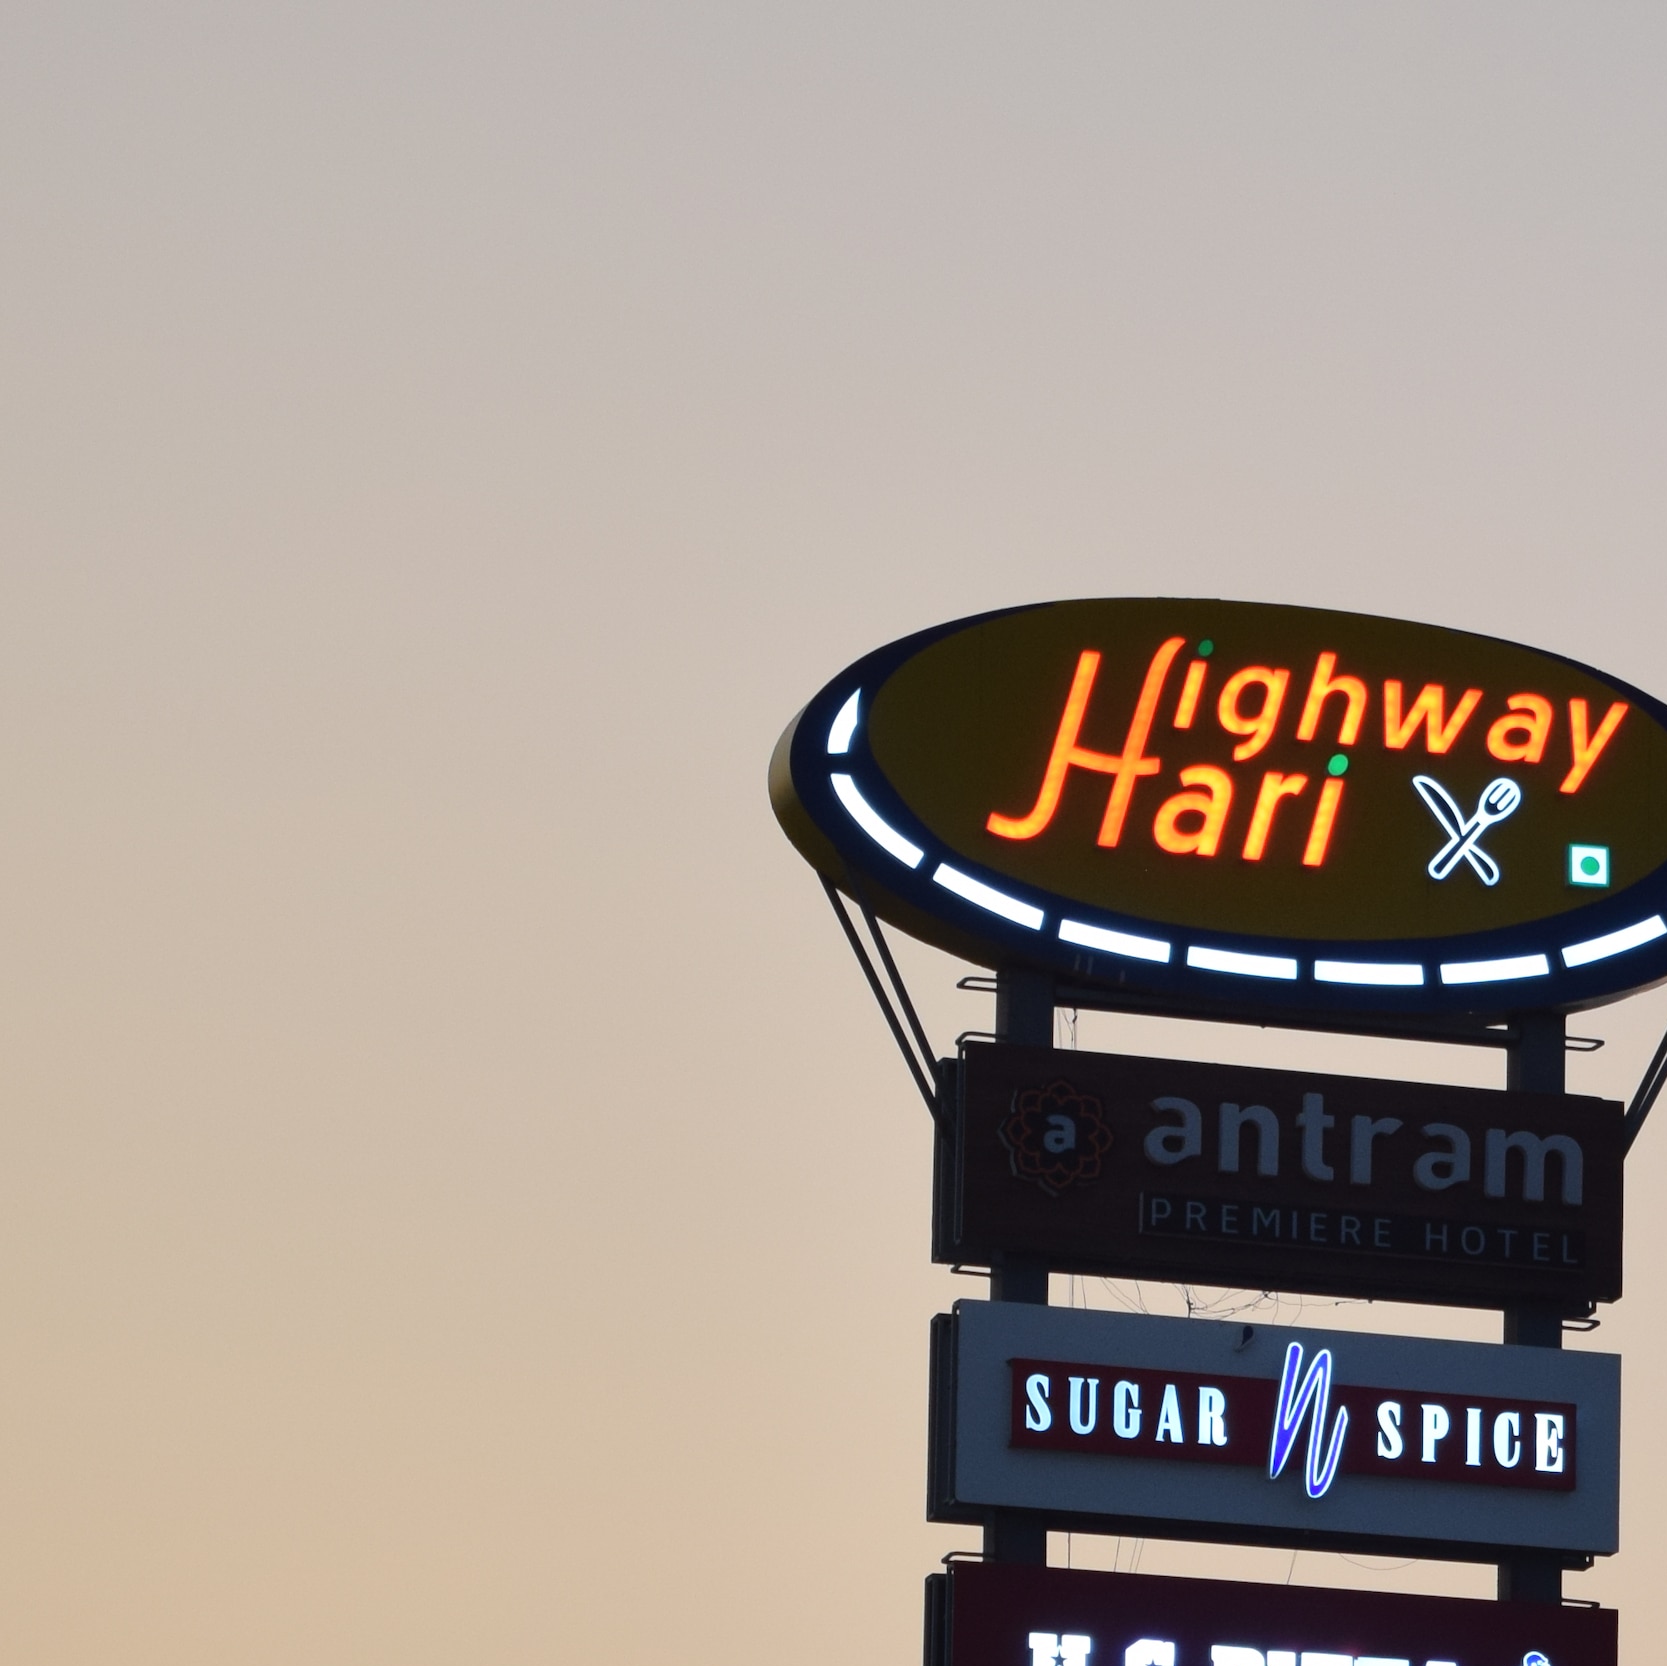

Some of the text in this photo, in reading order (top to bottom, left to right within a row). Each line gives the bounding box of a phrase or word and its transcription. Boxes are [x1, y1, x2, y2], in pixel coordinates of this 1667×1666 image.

[986, 637, 1630, 796] Highway
[986, 637, 1349, 867] Hari
[1143, 1091, 1584, 1206] antram
[1150, 1200, 1579, 1265] PREMIERE HOTEL
[1025, 1373, 1228, 1447] SUGAR
[1376, 1400, 1565, 1473] SPICE
